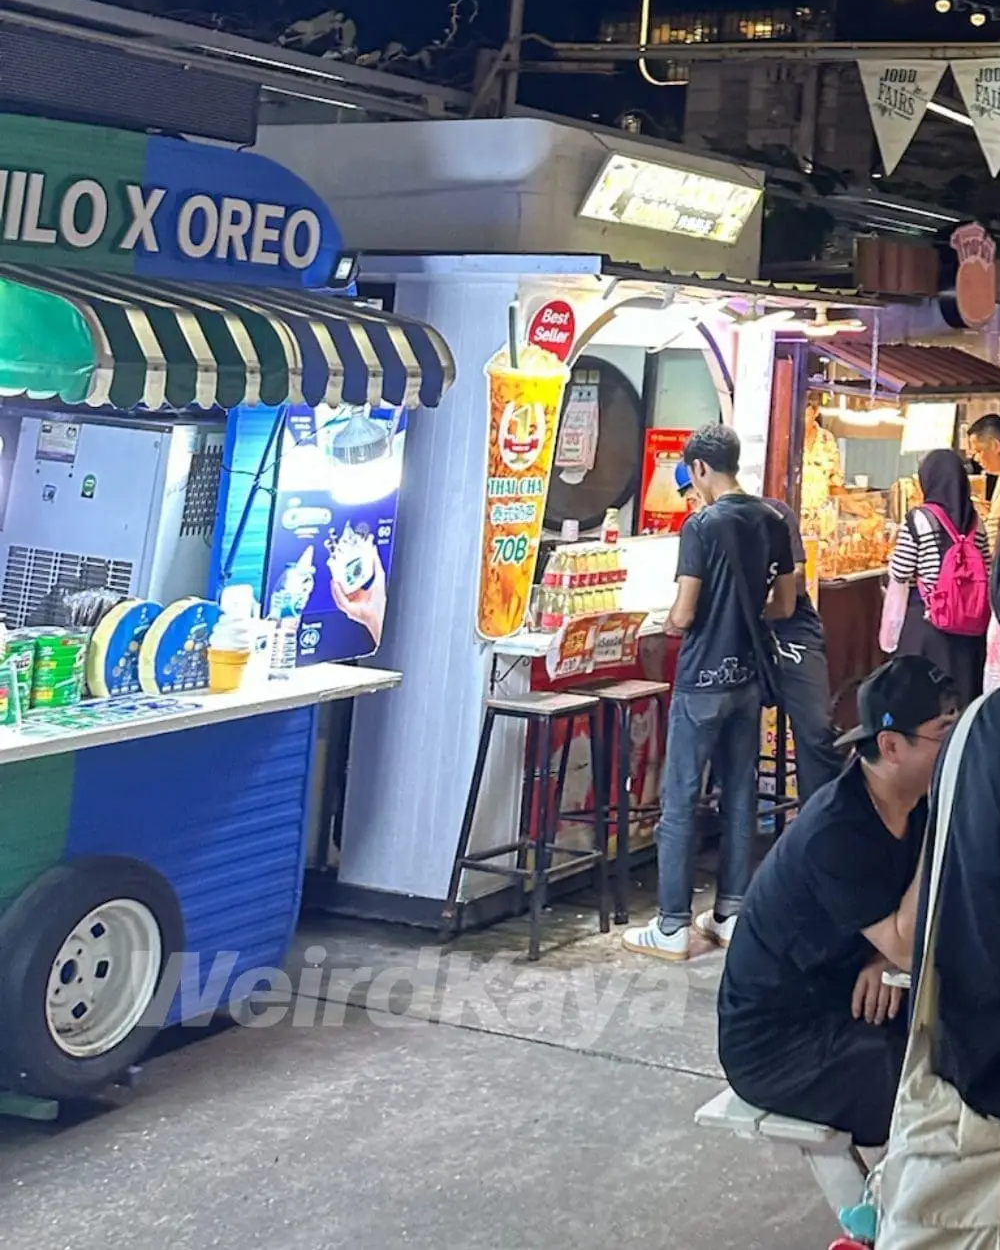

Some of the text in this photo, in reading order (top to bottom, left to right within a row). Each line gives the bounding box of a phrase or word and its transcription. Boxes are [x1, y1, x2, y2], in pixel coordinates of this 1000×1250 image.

[880, 68, 918, 83] JODD
[878, 83, 915, 116] FAIRS
[0, 169, 322, 269] ILO X OREO
[541, 308, 570, 325] Best
[533, 326, 570, 343] Seller
[490, 479, 542, 495] THAI CHA
